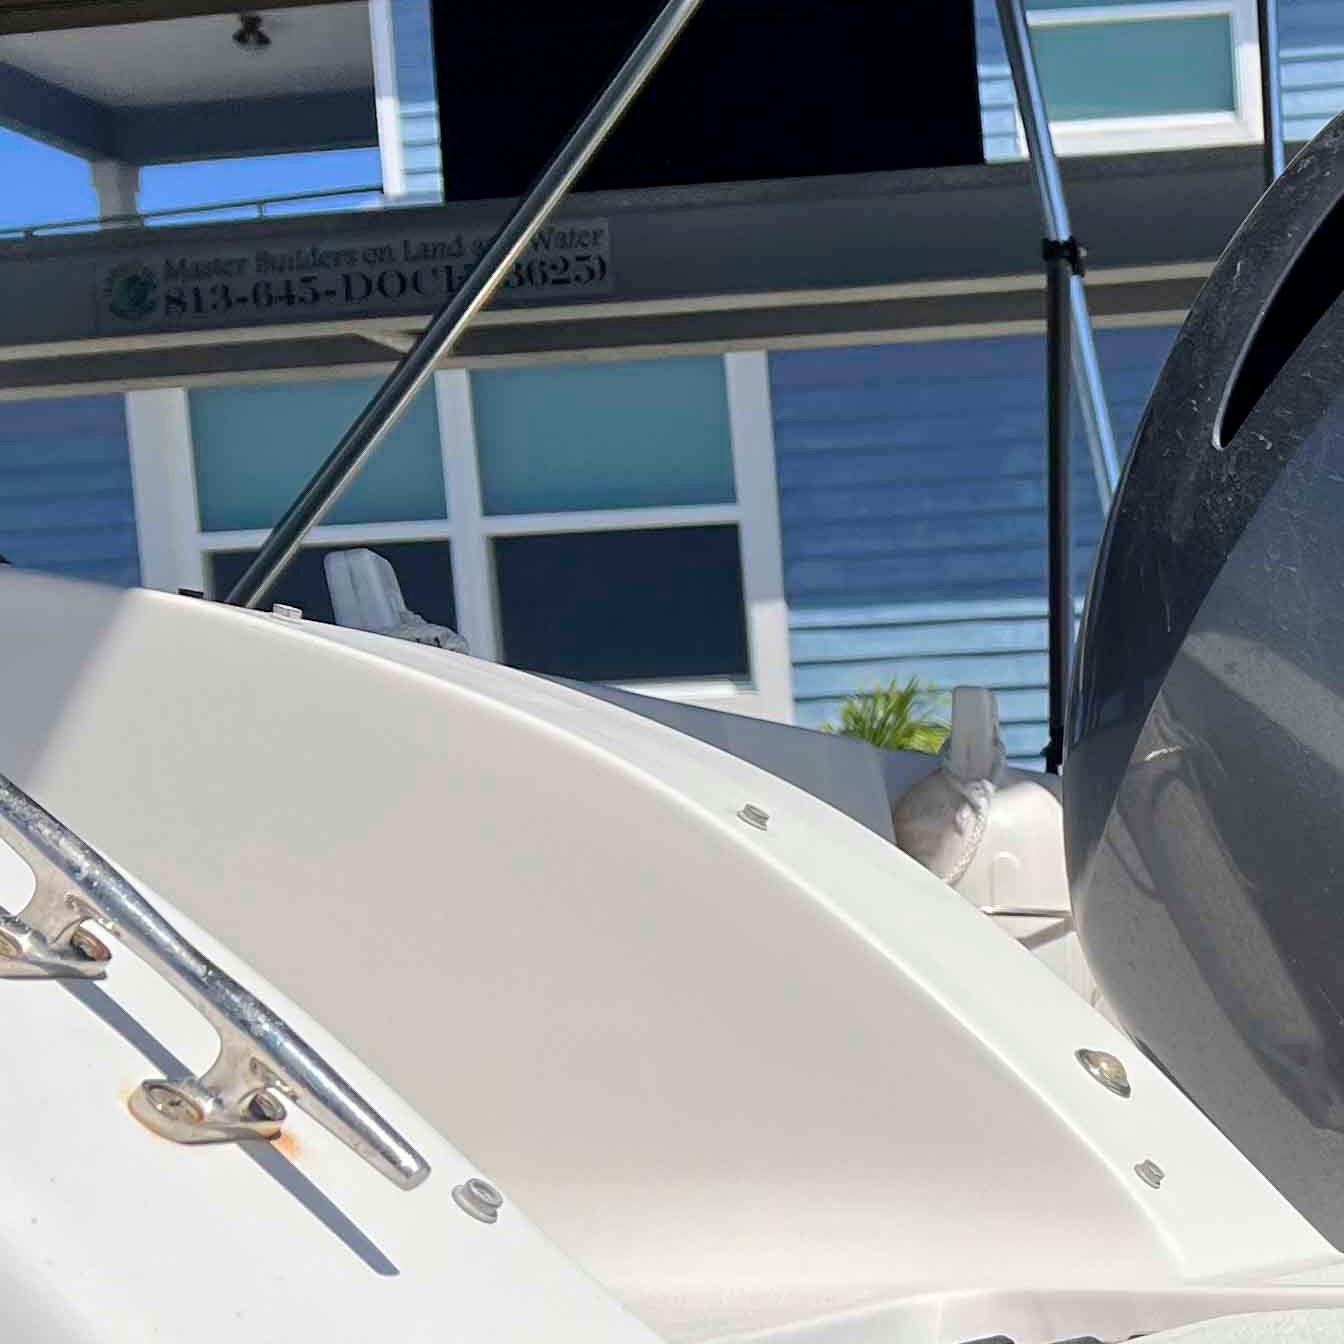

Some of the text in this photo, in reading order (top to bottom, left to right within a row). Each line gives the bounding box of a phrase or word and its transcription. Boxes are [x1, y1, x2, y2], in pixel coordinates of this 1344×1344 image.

[162, 257, 247, 281] Master
[255, 247, 357, 274] Builders
[361, 244, 395, 263] on
[402, 235, 463, 260] Land
[530, 227, 605, 252] Water
[503, 255, 607, 292] 3625)
